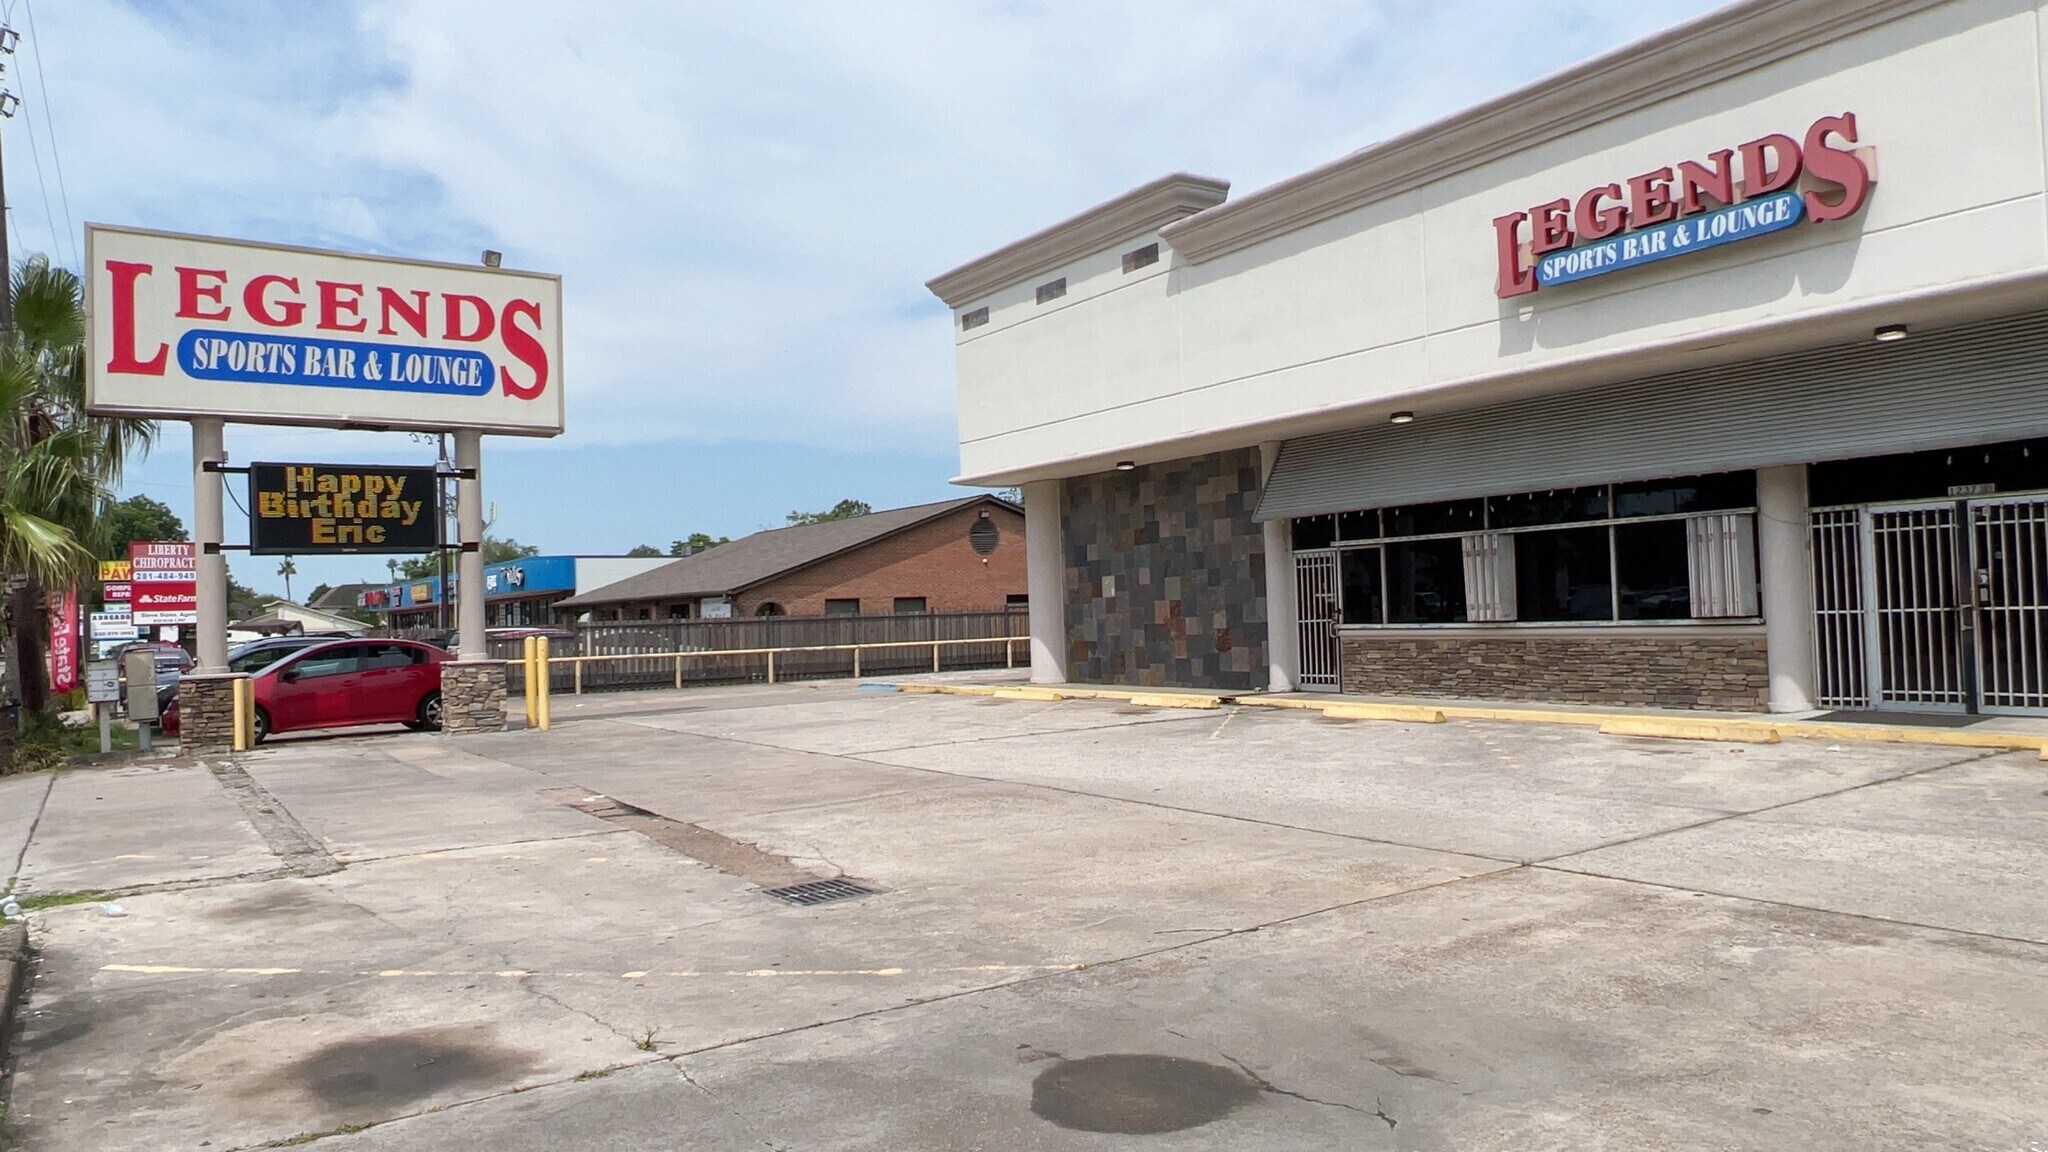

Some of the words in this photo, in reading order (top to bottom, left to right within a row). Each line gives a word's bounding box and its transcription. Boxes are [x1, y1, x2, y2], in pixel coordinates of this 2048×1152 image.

[1492, 111, 1870, 299] LEGENDS
[1542, 242, 1617, 281] SPORTS
[1622, 234, 1667, 261] BAR
[1672, 225, 1691, 248] &
[1696, 195, 1791, 241] LOUNGE
[105, 260, 550, 400] LEGENDS
[192, 338, 296, 376] SPORTS
[302, 345, 356, 380] BAR
[363, 350, 384, 382] &
[390, 352, 483, 388] LOUNGE
[286, 467, 407, 500] Happy
[258, 492, 422, 526] Birthday
[312, 517, 386, 544] Eric
[133, 557, 196, 569] CHIROPRACT
[148, 544, 190, 555] LIBERTY
[101, 568, 131, 579] PAW
